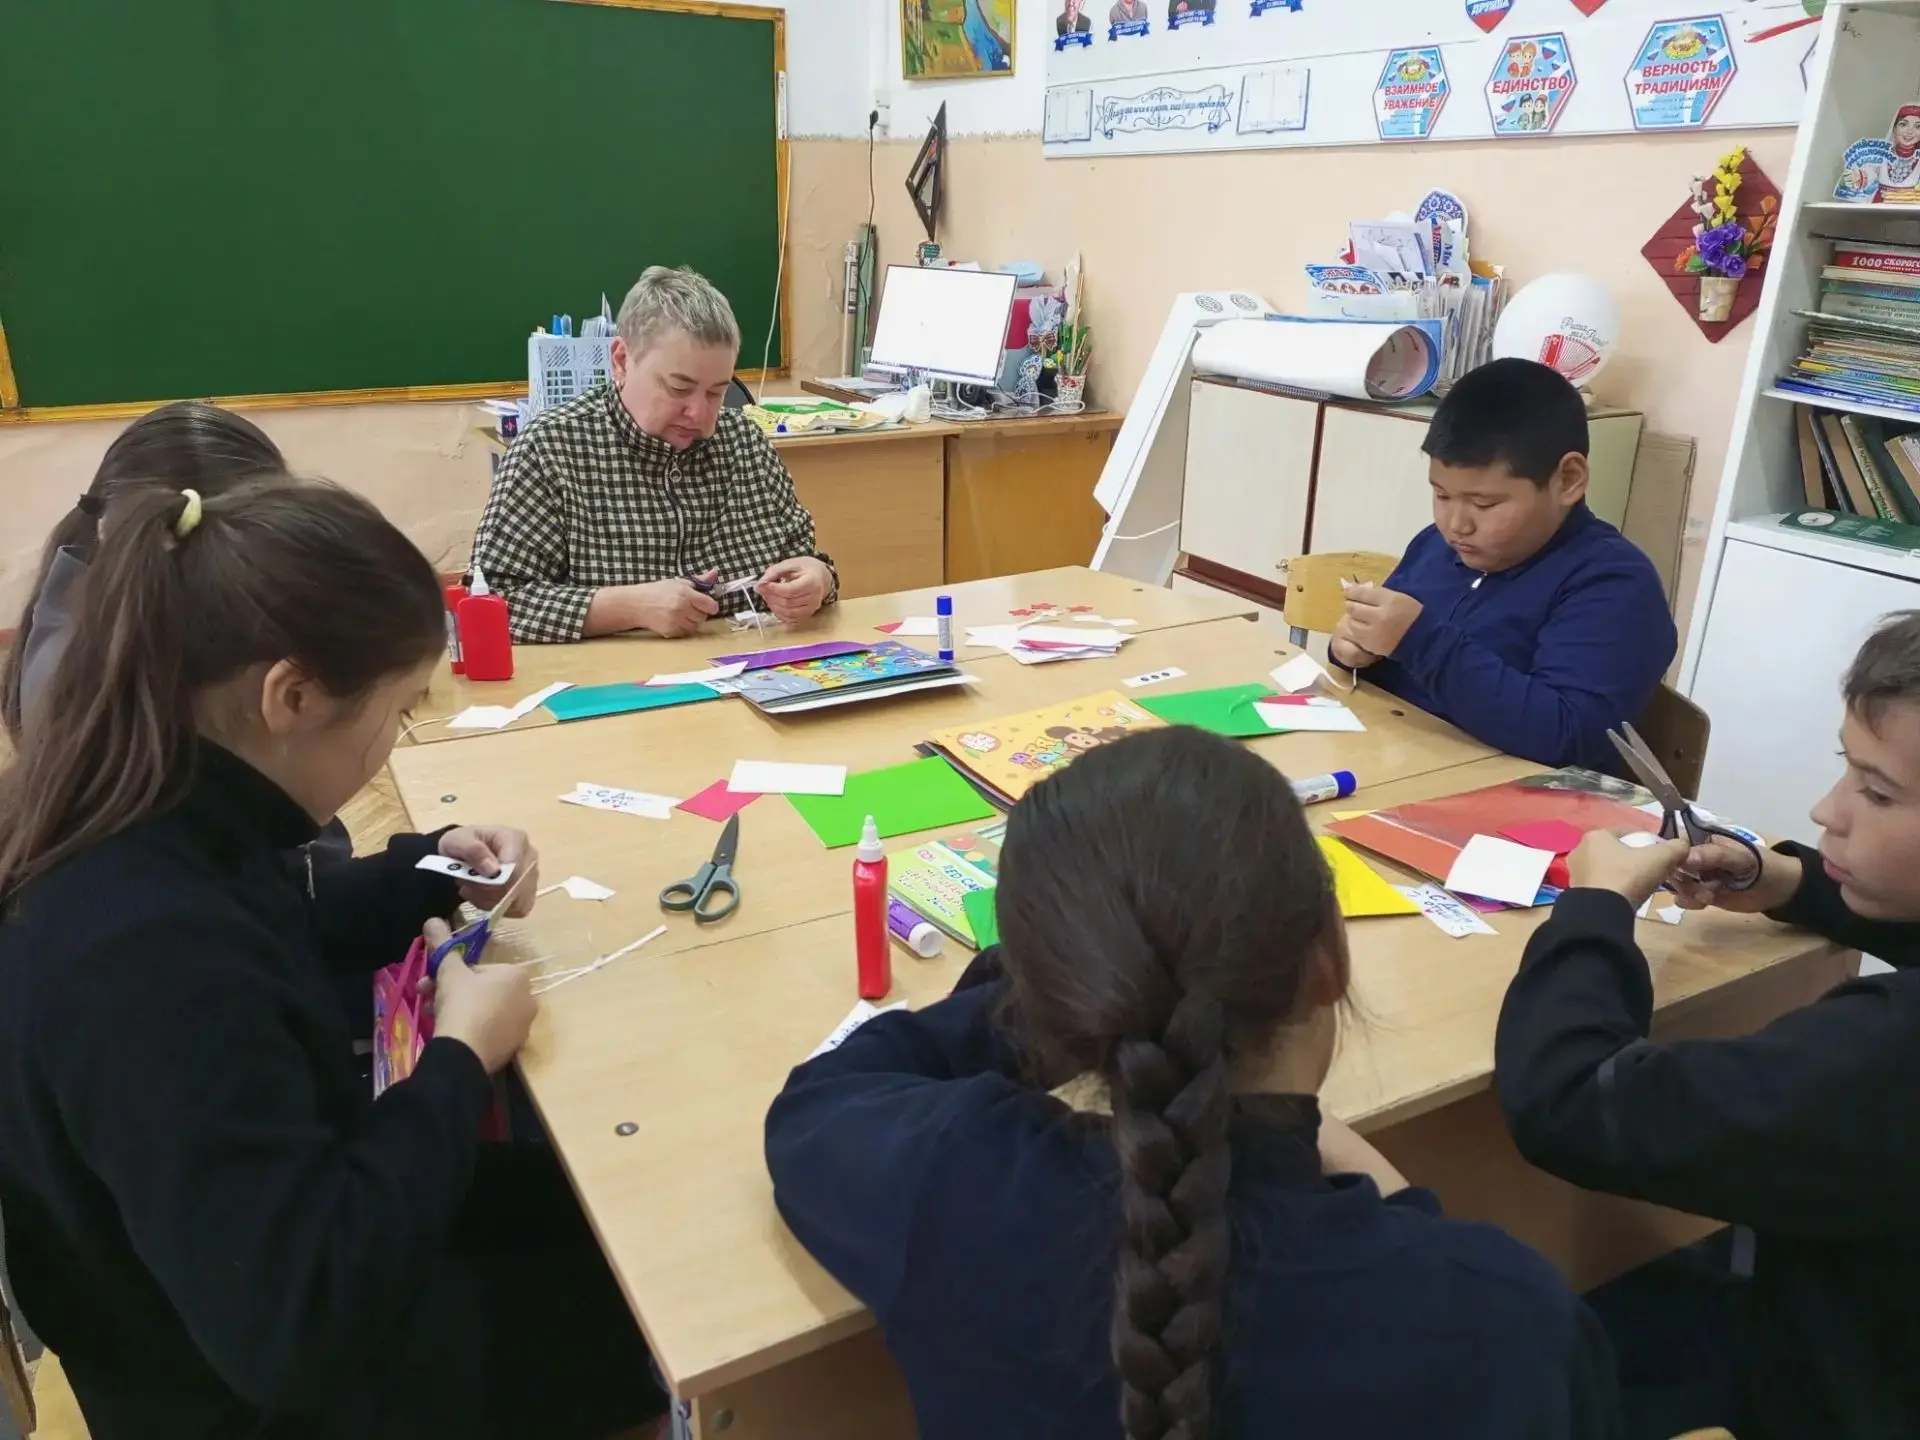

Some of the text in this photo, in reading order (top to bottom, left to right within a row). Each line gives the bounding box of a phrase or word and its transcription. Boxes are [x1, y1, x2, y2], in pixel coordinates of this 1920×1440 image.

[1642, 60, 1718, 78] ВЕРНОСТЬ
[1384, 82, 1439, 96] ВЗАИМНОЕ
[1492, 75, 1568, 94] ЕДИНСТВО
[1634, 75, 1726, 95] ТРАДИЦИЯМ!
[1852, 256, 1882, 267] 1000
